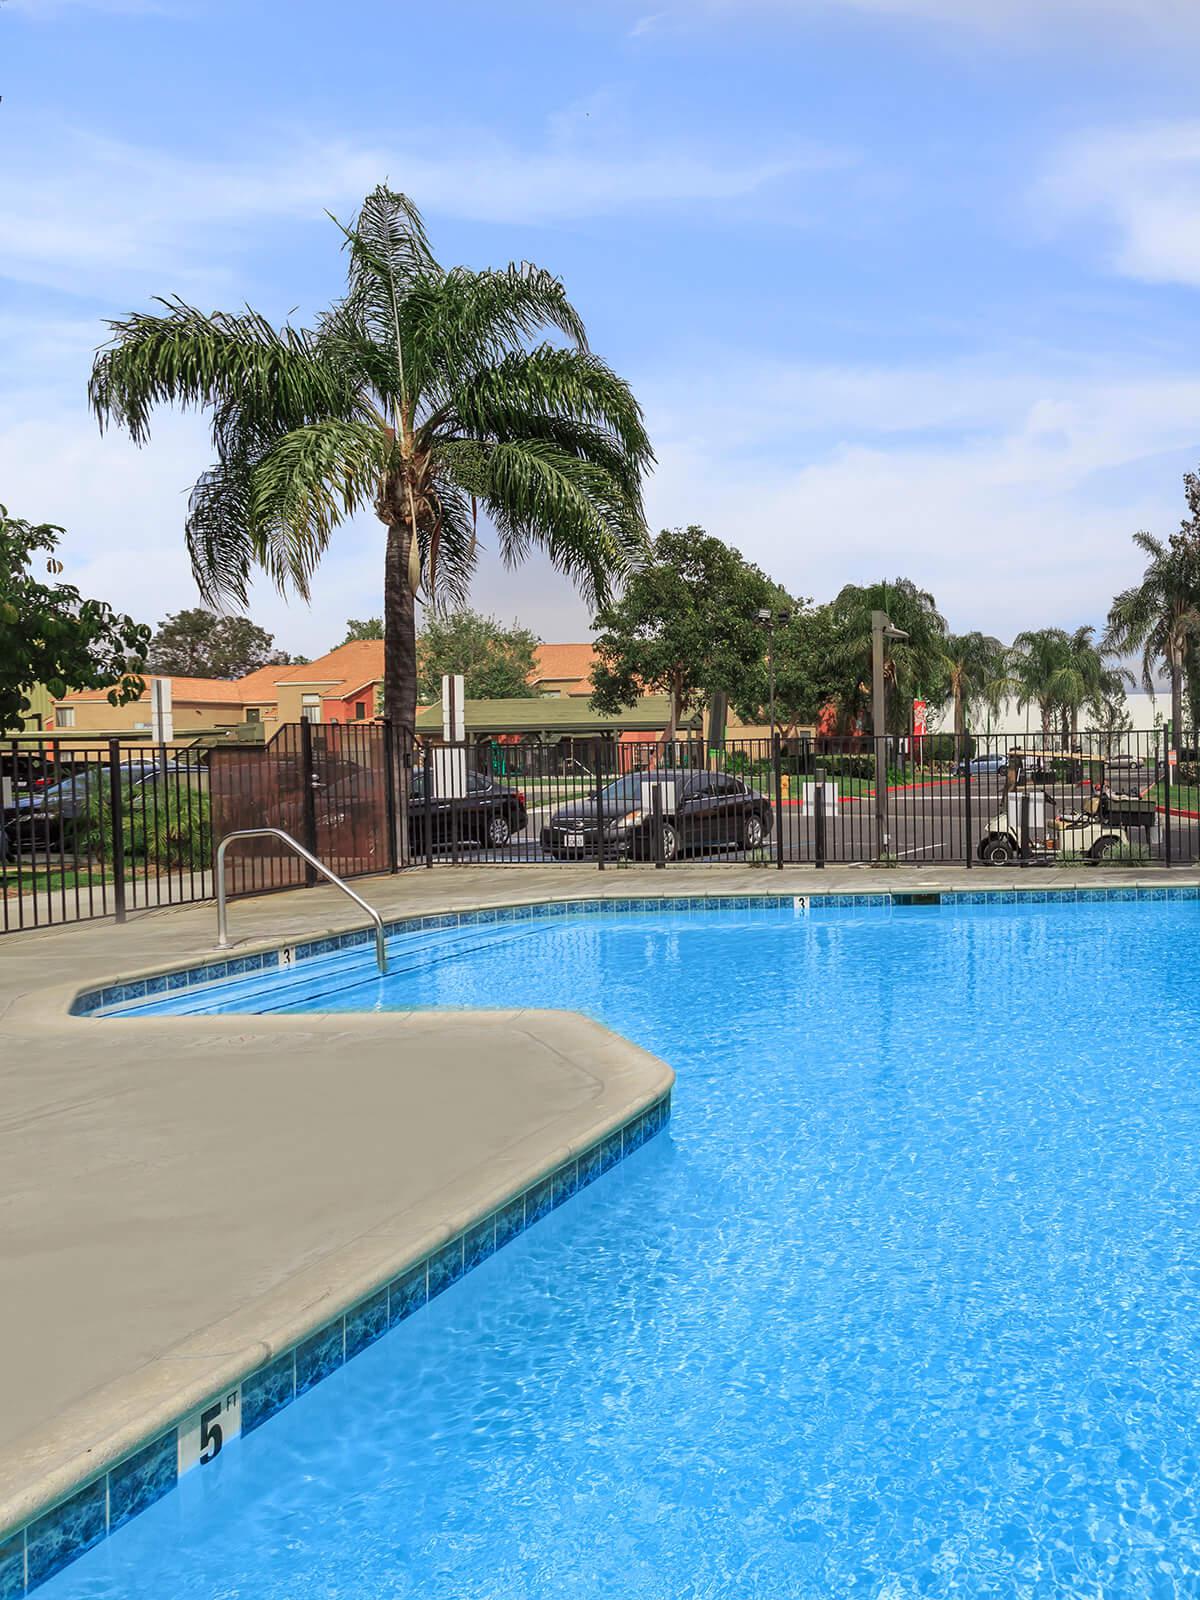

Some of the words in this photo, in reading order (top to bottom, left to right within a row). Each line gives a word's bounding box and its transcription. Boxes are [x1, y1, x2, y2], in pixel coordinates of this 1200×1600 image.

[799, 898, 805, 908] 3
[284, 949, 290, 963] 3
[200, 1402, 222, 1465] 5
[227, 1390, 238, 1412] FT
